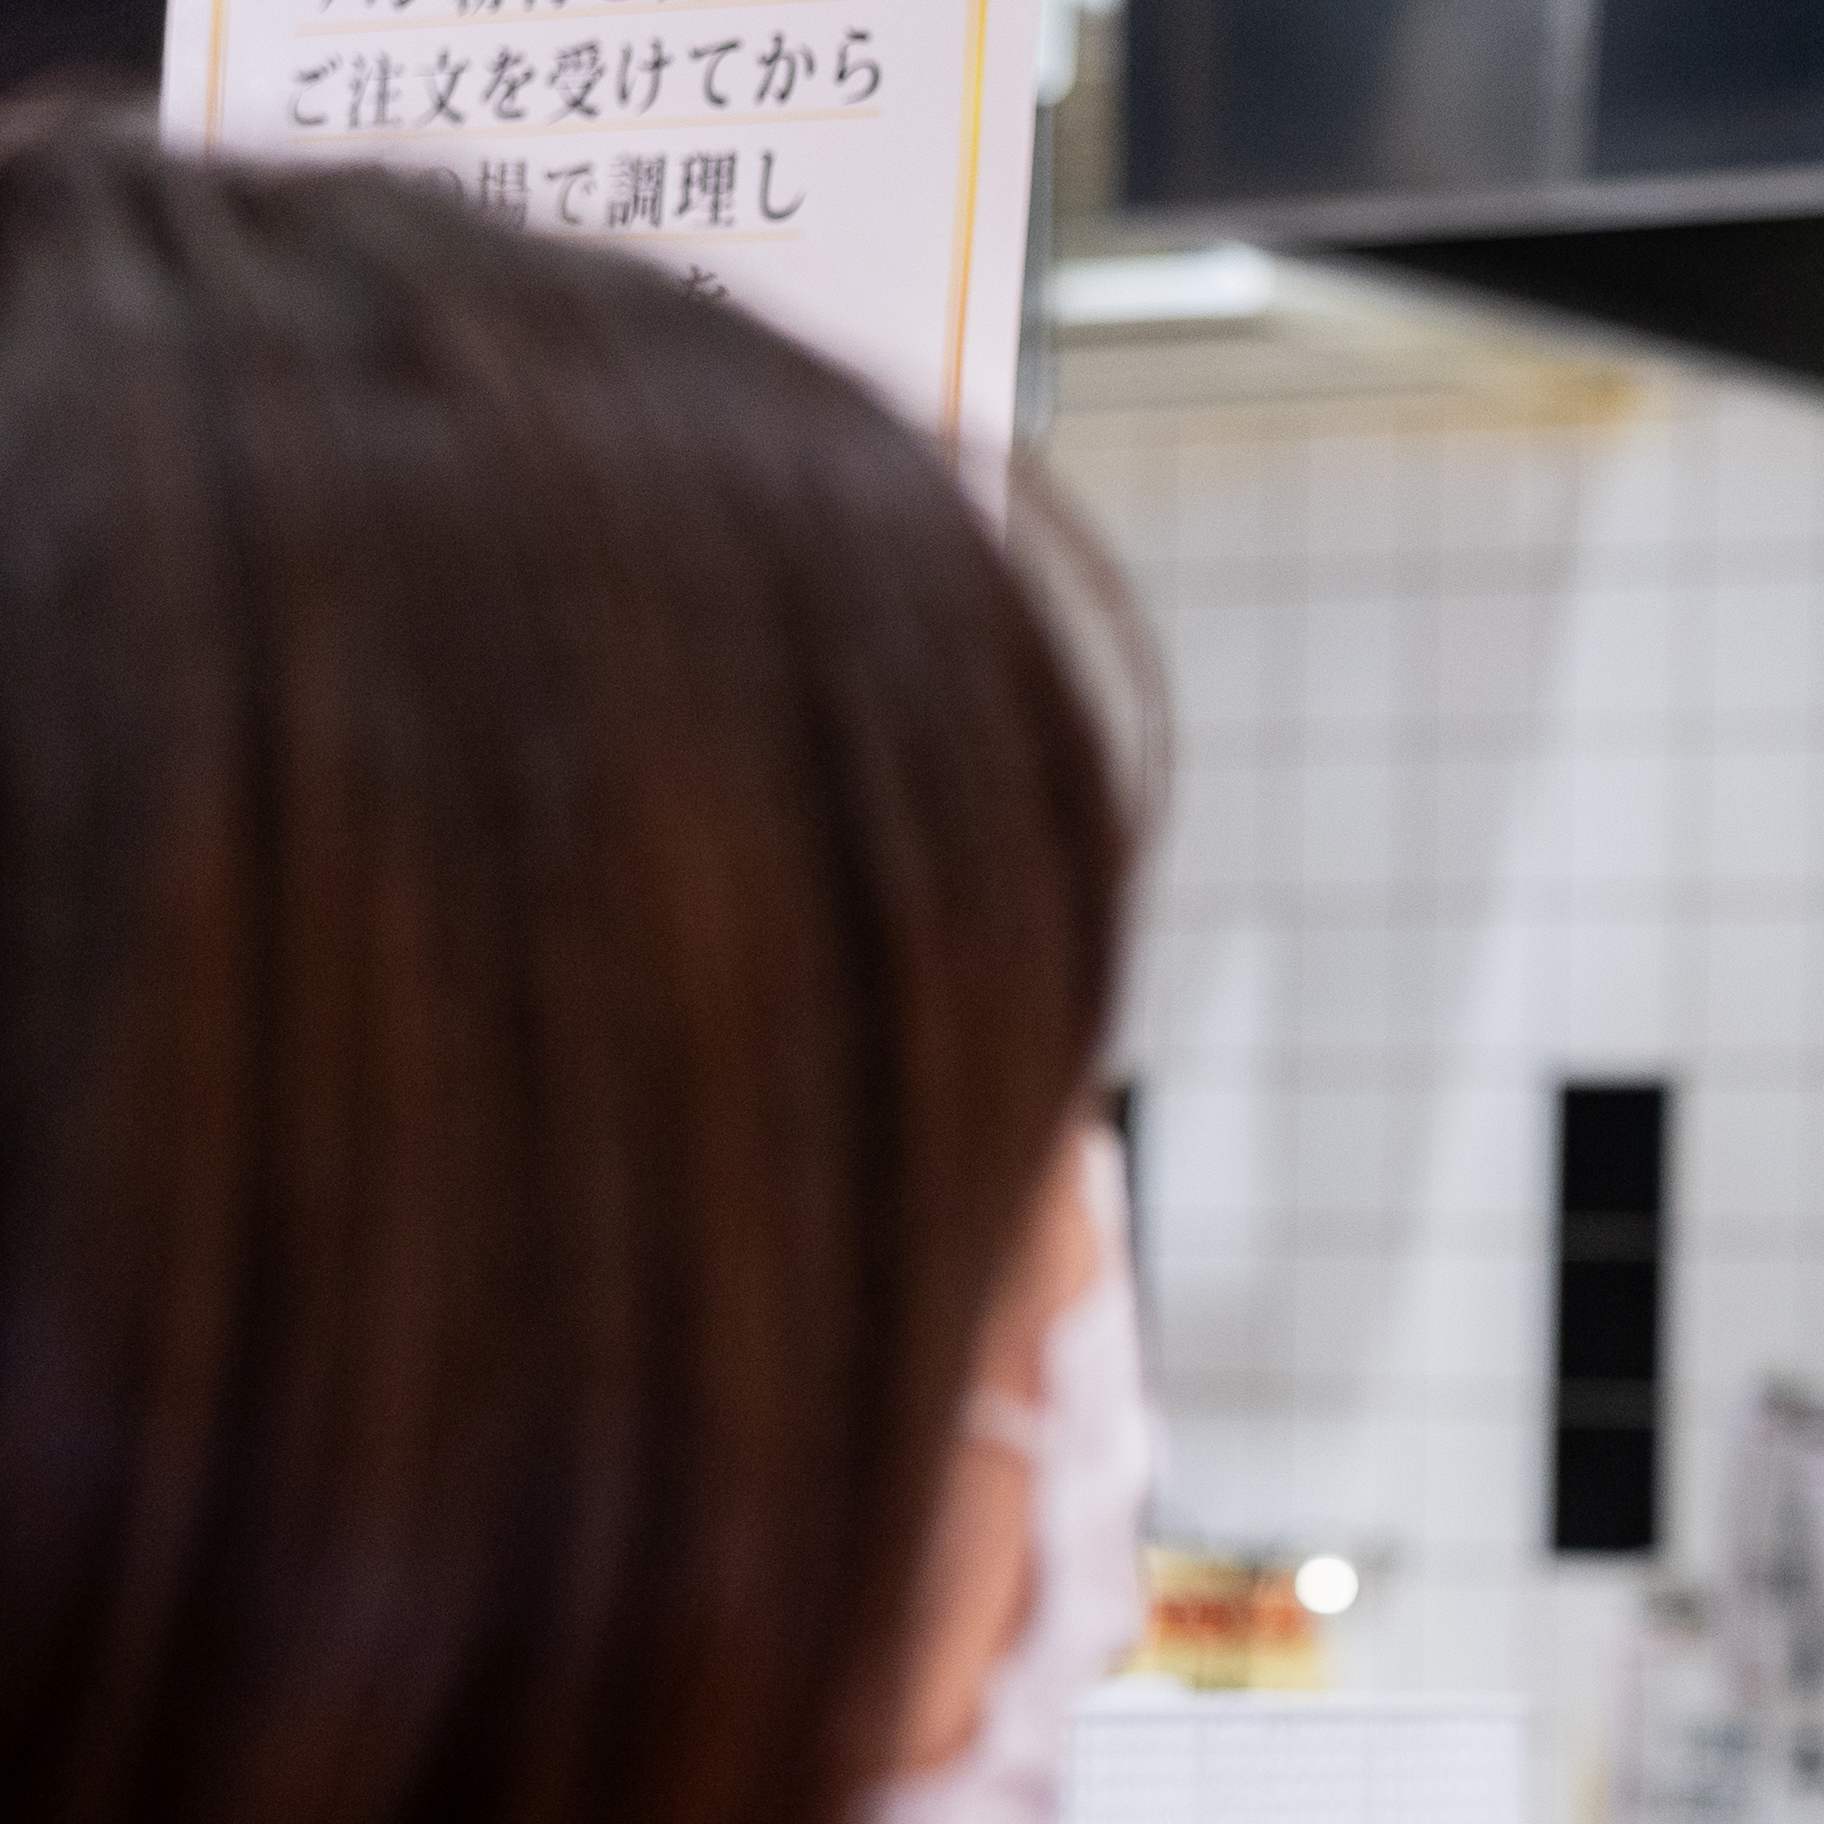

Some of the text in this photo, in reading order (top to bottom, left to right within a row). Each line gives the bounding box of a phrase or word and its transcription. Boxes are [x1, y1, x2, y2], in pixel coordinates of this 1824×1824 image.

[285, 27, 884, 132] ご注文を受けてから
